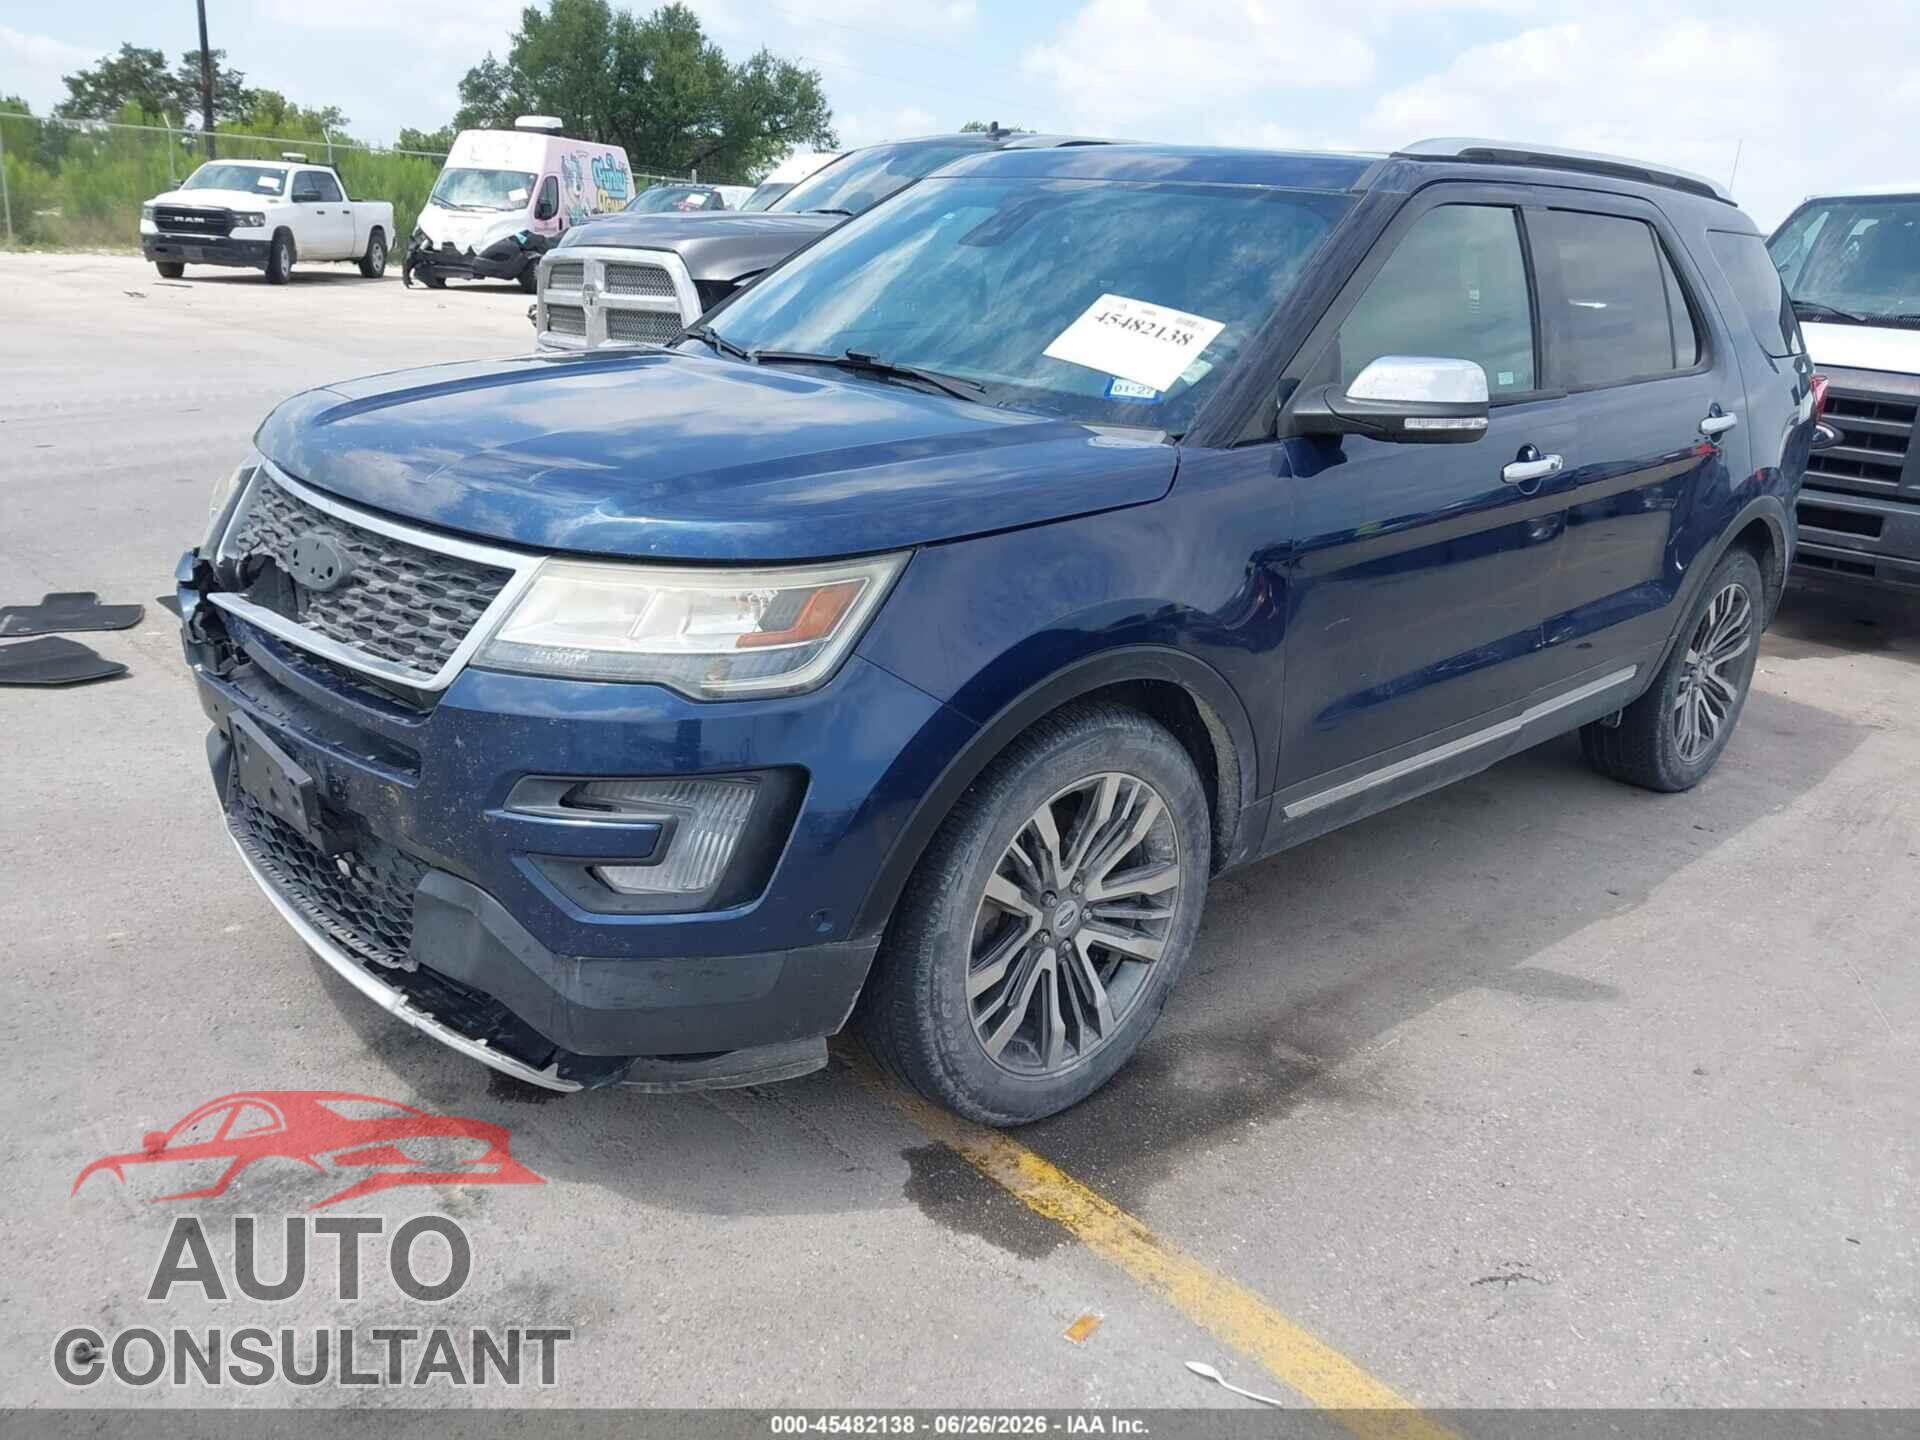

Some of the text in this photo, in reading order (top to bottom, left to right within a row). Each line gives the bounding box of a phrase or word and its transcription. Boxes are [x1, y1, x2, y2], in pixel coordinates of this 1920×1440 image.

[174, 215, 205, 223] RAM
[1094, 311, 1194, 346] 45482138
[1114, 383, 1154, 396] 01-27
